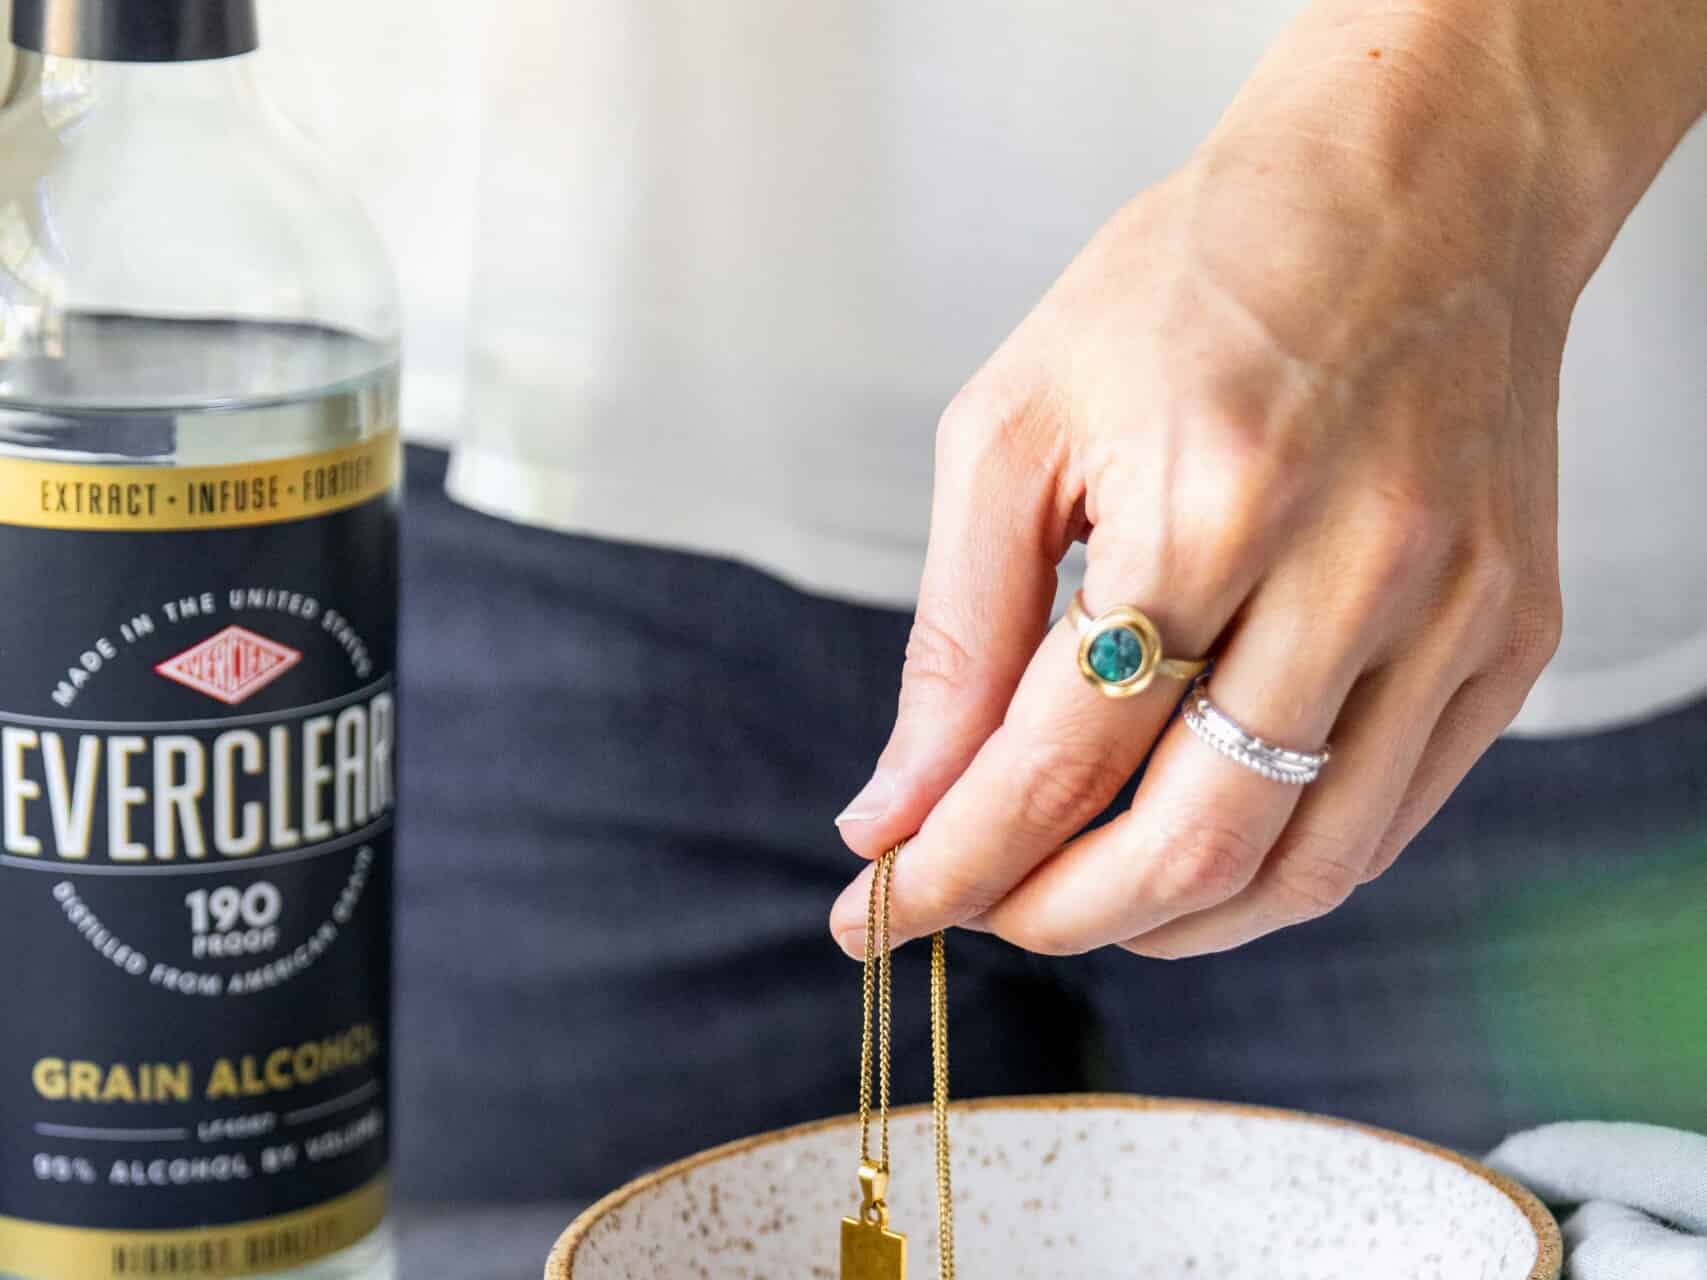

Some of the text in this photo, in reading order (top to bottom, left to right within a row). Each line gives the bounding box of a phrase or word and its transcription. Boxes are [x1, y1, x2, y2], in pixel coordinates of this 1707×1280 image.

[40, 480, 157, 516] EXTRACT
[187, 475, 280, 515] INFUSE
[52, 636, 118, 707] MADE
[119, 613, 156, 643] IN
[163, 592, 217, 622] THE
[229, 588, 319, 620] UNITED
[1, 692, 394, 860] EVERCLEAR
[184, 881, 282, 933] 190
[192, 926, 280, 959] PROOF
[150, 963, 222, 996] FROM
[32, 1056, 191, 1102] GRAIN
[109, 1153, 251, 1187] ALCOHOL
[261, 1144, 298, 1173] BY
